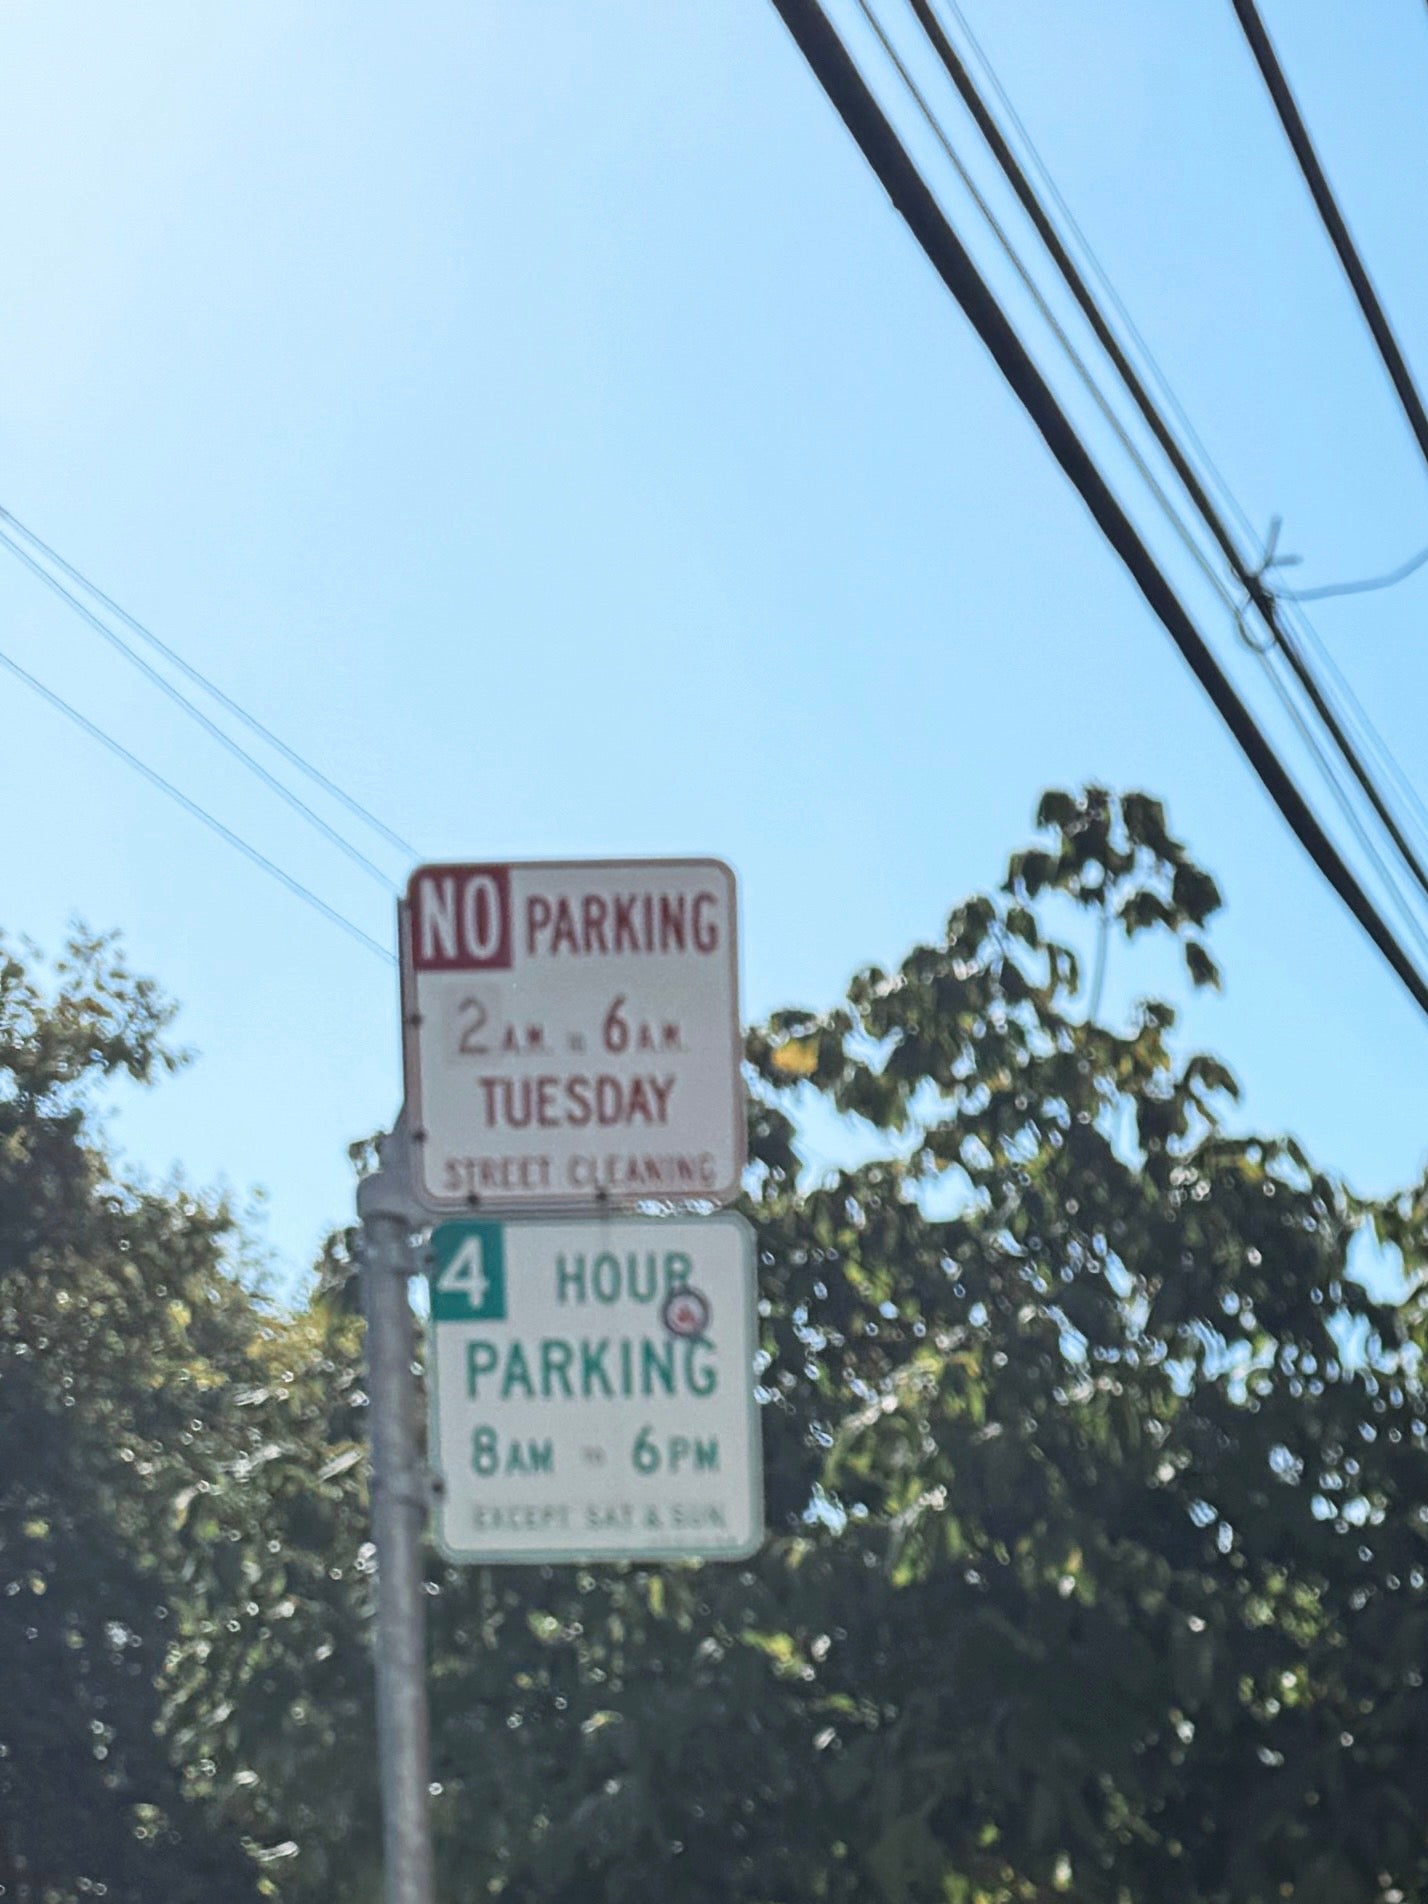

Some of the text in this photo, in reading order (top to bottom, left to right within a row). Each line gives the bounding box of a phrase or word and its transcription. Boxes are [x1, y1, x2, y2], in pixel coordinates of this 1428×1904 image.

[420, 874, 720, 960] NO PARKING
[479, 1076, 676, 1129] TUESDAY
[445, 1151, 717, 1189] STREET CLEANING
[437, 1235, 693, 1309] 4 HOUR
[466, 1337, 718, 1399] PARKING
